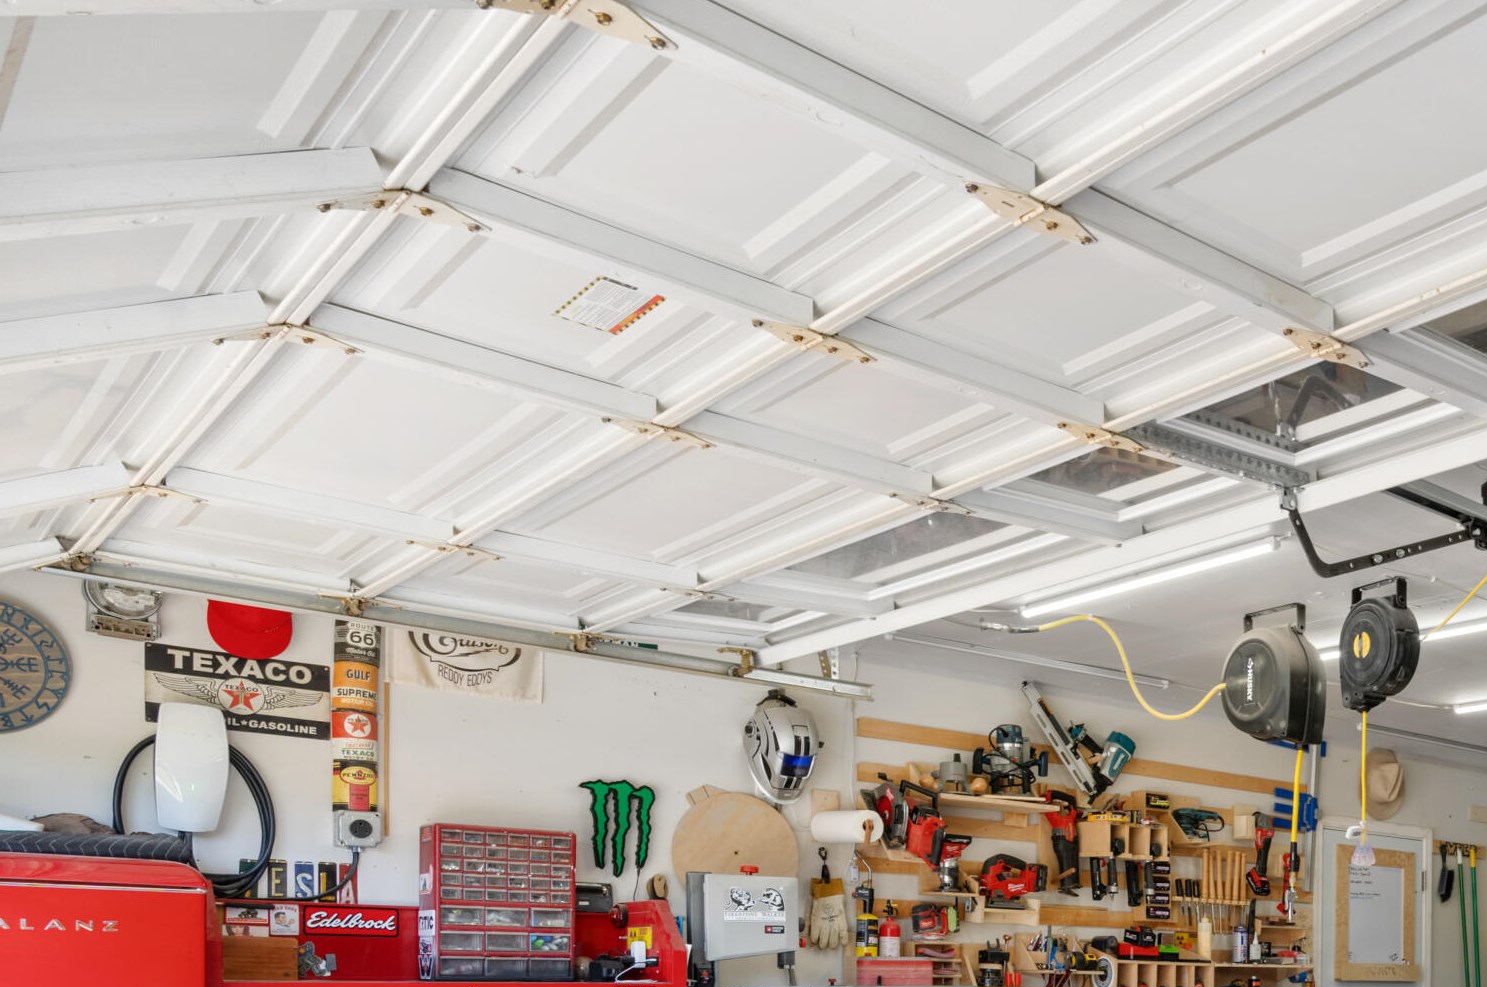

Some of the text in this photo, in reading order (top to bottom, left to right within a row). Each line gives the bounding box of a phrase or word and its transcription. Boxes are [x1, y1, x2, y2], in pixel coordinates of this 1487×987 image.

[350, 622, 374, 631] ROUTE
[350, 631, 374, 646] 66
[167, 648, 312, 685] TEXACO
[346, 668, 371, 681] GULF
[437, 664, 493, 687] REDDY EDDYS
[224, 683, 259, 692] TEXACO
[1246, 669, 1254, 701] HUSKY
[248, 719, 318, 735] GASOLINE
[341, 749, 375, 757] TEXACO
[239, 867, 357, 904] ESLA
[306, 911, 396, 931] Edelbrock
